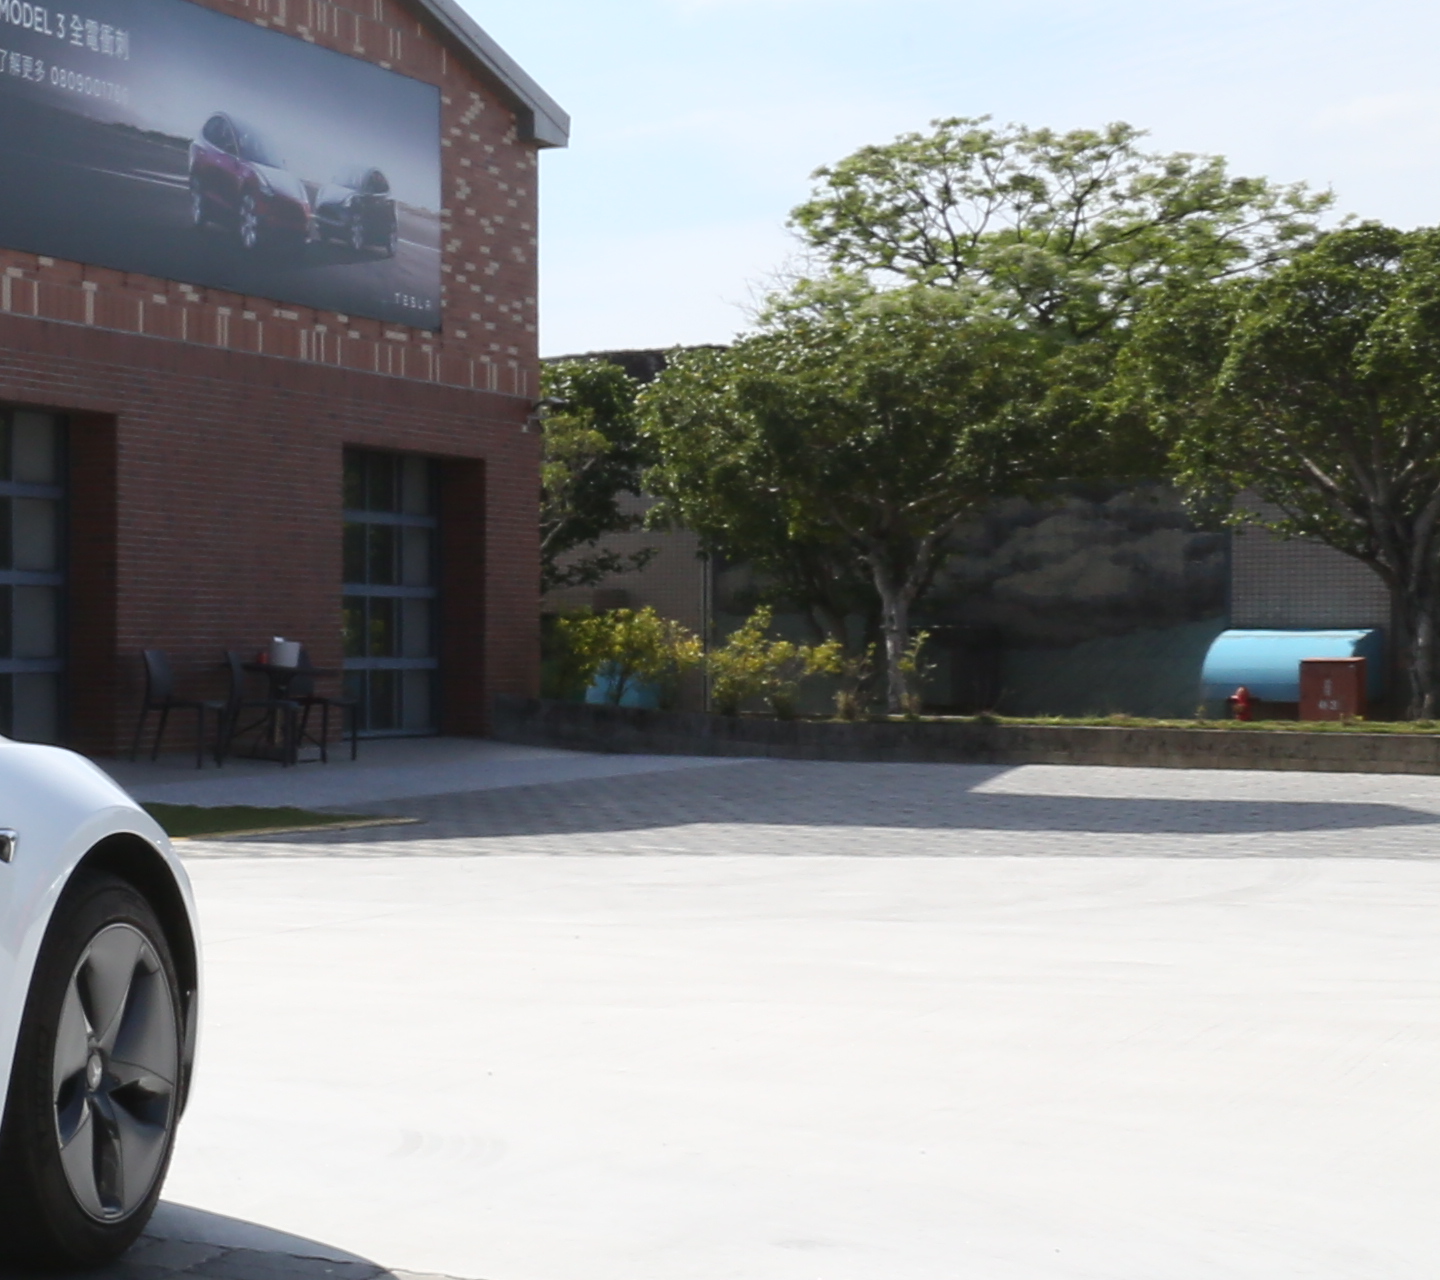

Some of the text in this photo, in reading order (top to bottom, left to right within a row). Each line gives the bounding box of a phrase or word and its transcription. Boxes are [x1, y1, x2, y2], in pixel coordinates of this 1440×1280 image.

[56, 12, 66, 39] 3
[69, 13, 130, 61] 全電衝刺
